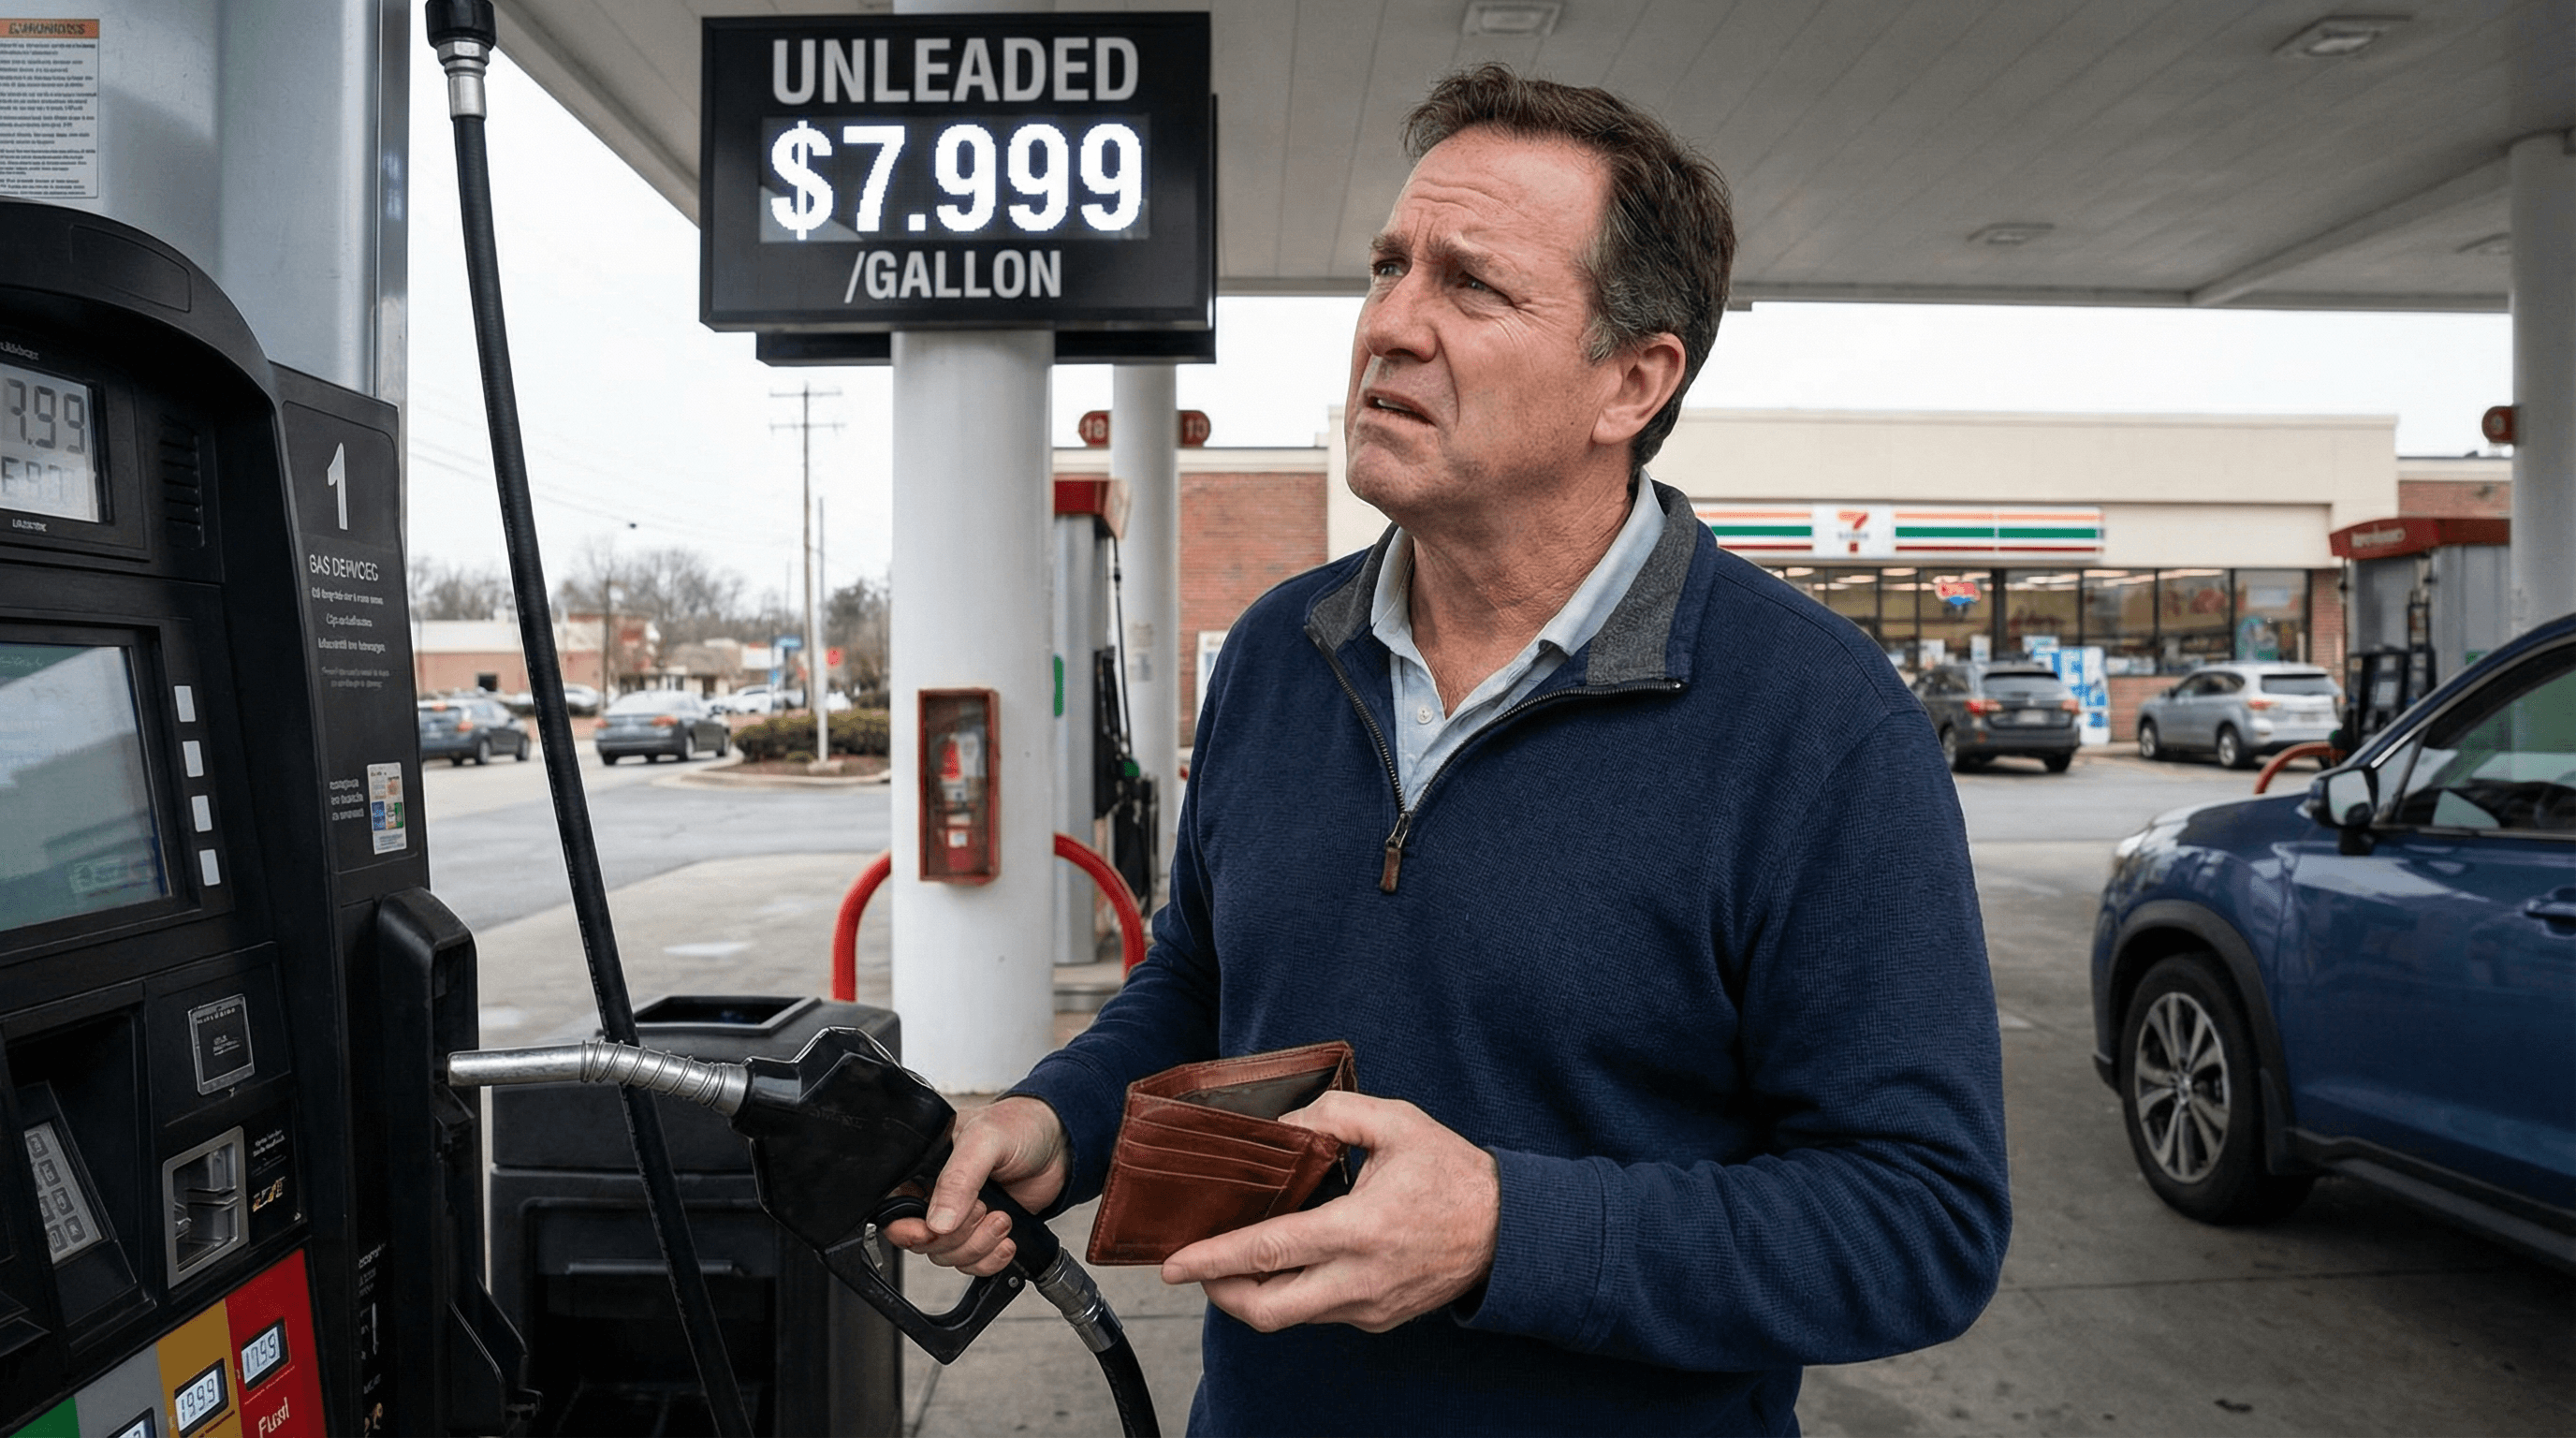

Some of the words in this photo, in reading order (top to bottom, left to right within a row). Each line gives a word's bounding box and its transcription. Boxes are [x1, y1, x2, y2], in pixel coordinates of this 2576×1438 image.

[772, 37, 1139, 106] UNLEADED
[770, 121, 1143, 241] $7.999
[844, 250, 1062, 304] /GALLON
[328, 442, 348, 531] 1
